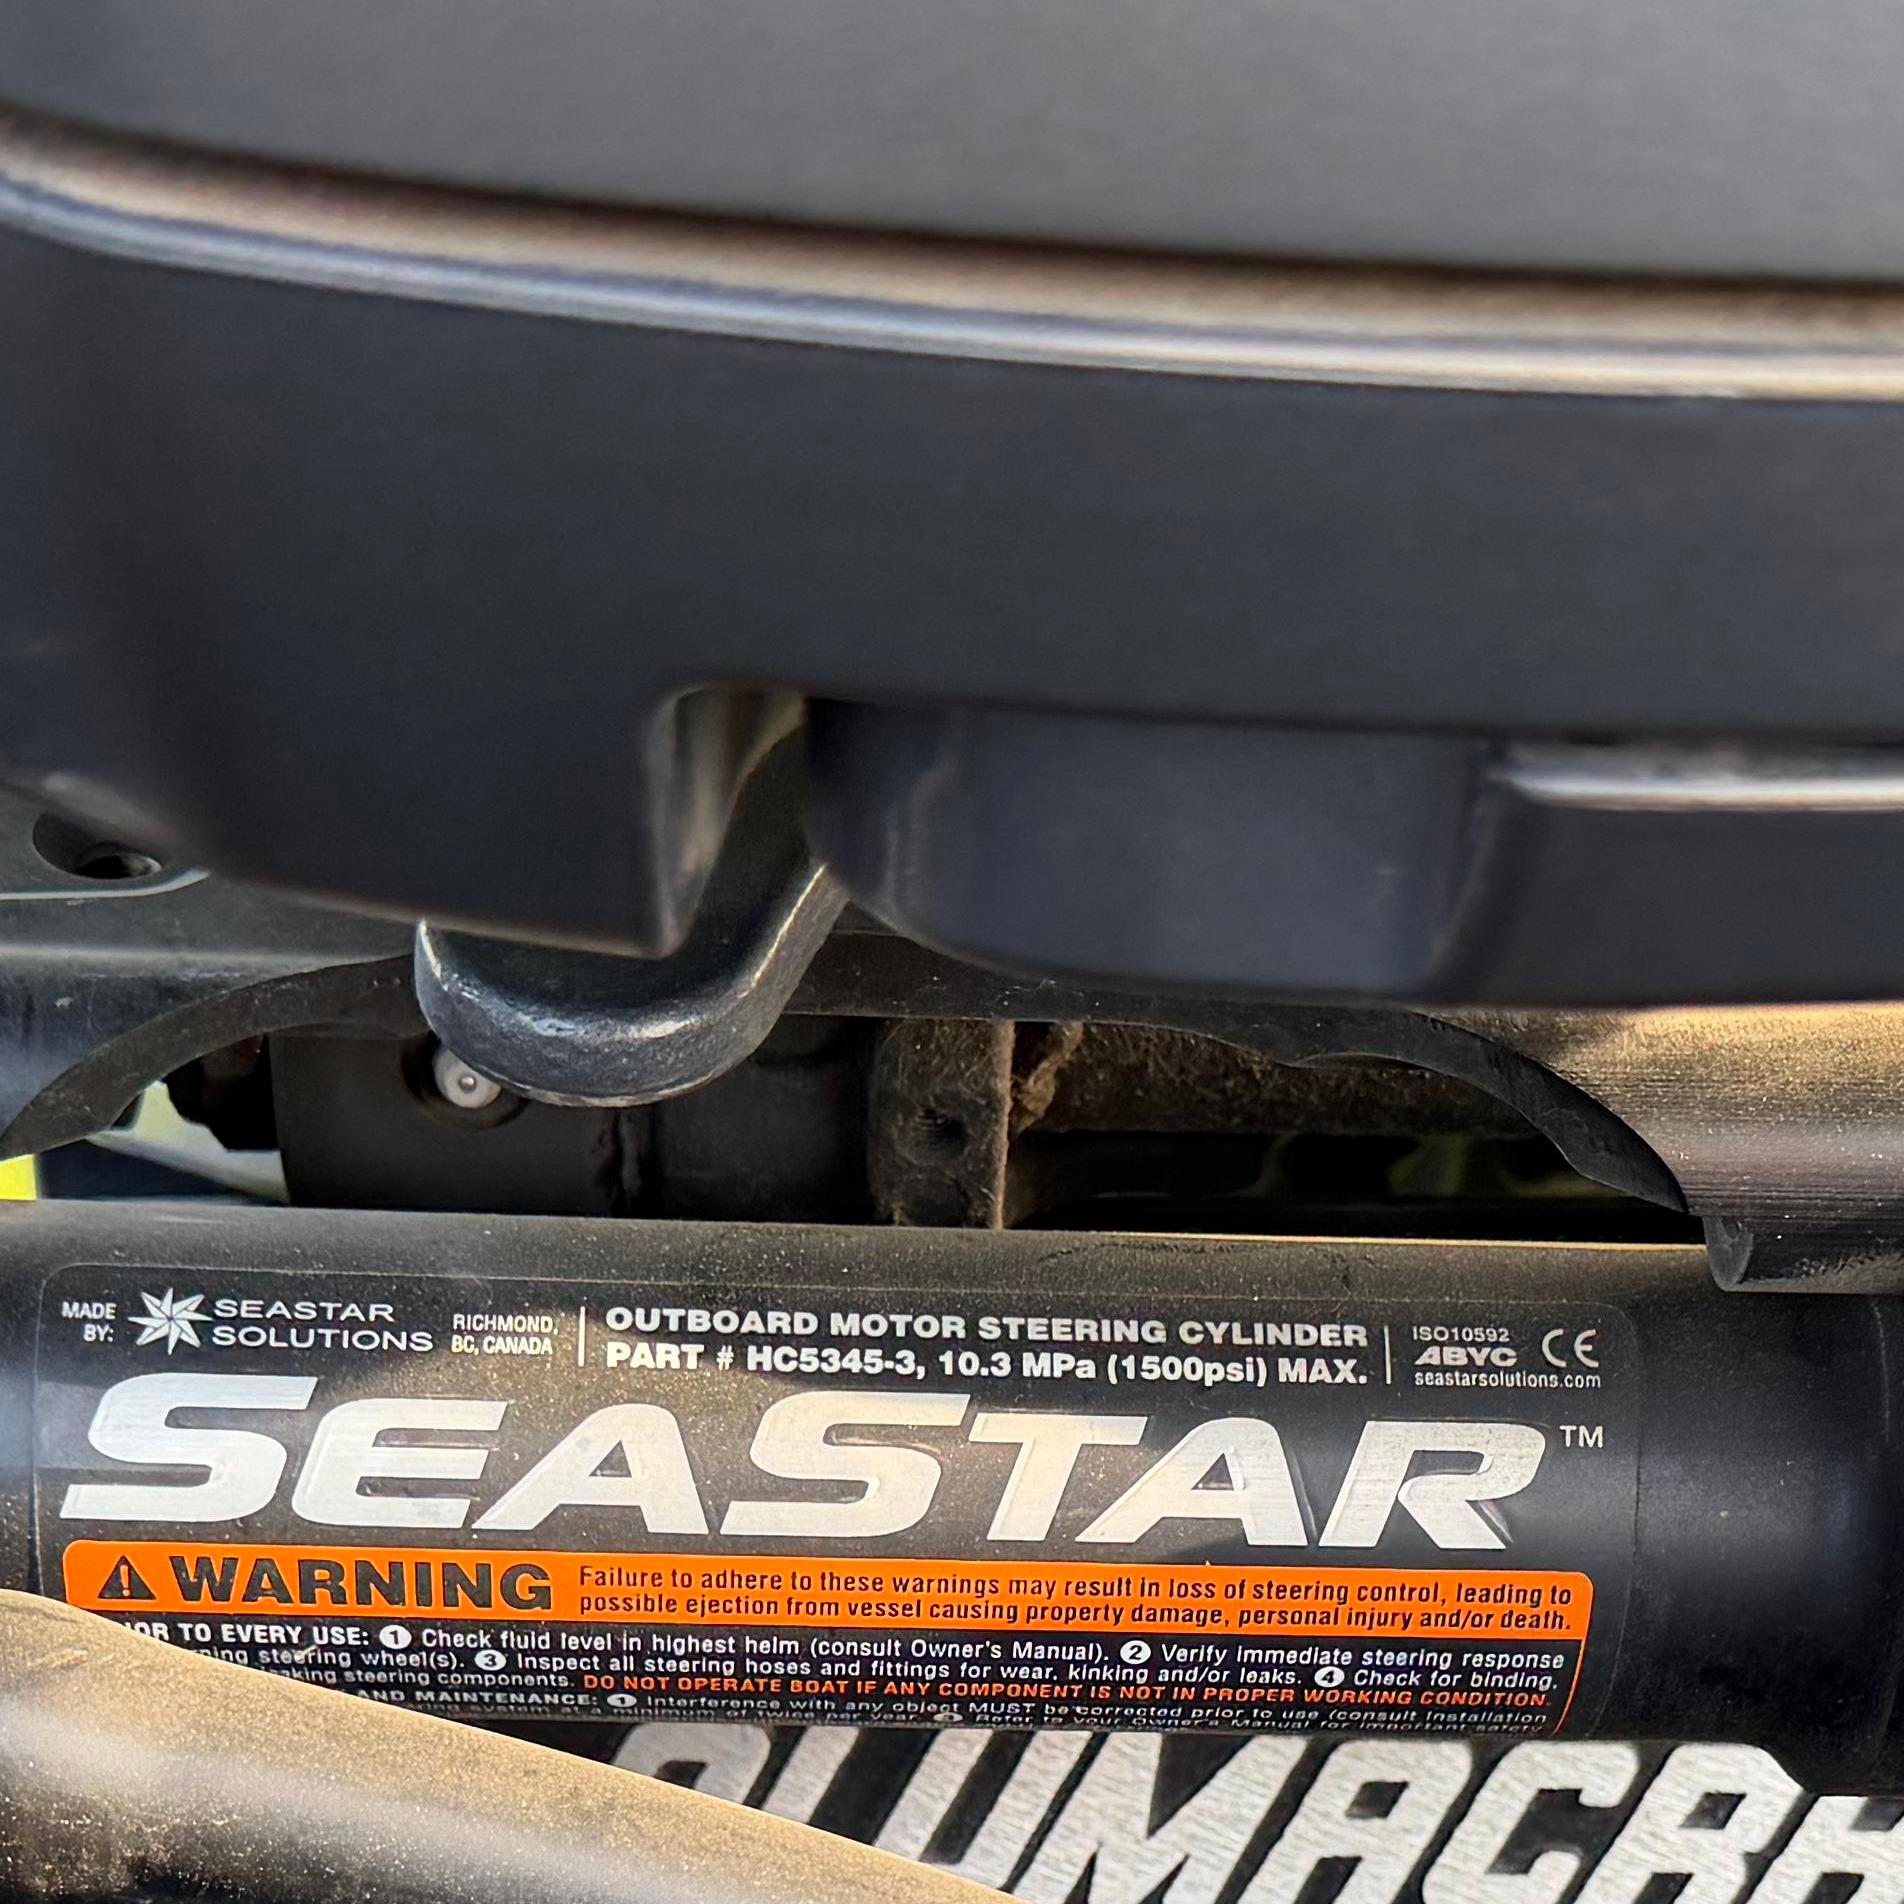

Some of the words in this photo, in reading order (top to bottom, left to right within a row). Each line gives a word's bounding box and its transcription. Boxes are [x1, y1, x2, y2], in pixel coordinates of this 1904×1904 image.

[61, 1301, 116, 1321] MADE
[213, 1299, 395, 1322] SEASTAR
[453, 1313, 559, 1335] RICHMOND,
[82, 1323, 114, 1343] BY:
[211, 1326, 434, 1351] SOLUTIONS
[606, 1307, 819, 1337] OUTBOARD
[829, 1312, 966, 1340] MOTOR
[978, 1316, 1167, 1344] STEERING
[1179, 1322, 1368, 1347] CYLINDER
[1412, 1326, 1510, 1342] ISO10592
[451, 1335, 479, 1357] BC,
[482, 1336, 554, 1356] CANADA
[1414, 1346, 1518, 1367] ABYC
[606, 1342, 704, 1369] PART
[717, 1346, 734, 1371] #
[747, 1347, 925, 1380] HC5345-3,
[939, 1351, 1011, 1378] 10.3
[1022, 1353, 1096, 1381] MPa
[1107, 1354, 1268, 1388] (1500psi)
[1278, 1358, 1368, 1386] MAX.
[1414, 1370, 1602, 1389] seastarsolutions.com
[59, 1371, 1546, 1551] SEASTAR
[169, 1555, 553, 1610] WARNING
[580, 1566, 663, 1589] Failure
[671, 1570, 693, 1589] to
[701, 1570, 783, 1591] adhere
[791, 1571, 813, 1591] to
[821, 1572, 884, 1593] these
[893, 1575, 1000, 1599] warnings
[1008, 1580, 1057, 1600] may
[1064, 1576, 1132, 1598] result
[1140, 1578, 1160, 1598] in
[1168, 1578, 1217, 1600] loss
[1224, 1579, 1248, 1601] of
[1253, 1581, 1349, 1606] steering
[1356, 1583, 1447, 1608] control,
[1456, 1583, 1543, 1609] leading
[1550, 1585, 1572, 1605] to
[580, 1594, 678, 1617] possible
[686, 1595, 779, 1618] ejection
[787, 1597, 840, 1617] from
[848, 1598, 922, 1619] vessel
[930, 1600, 1019, 1625] causing
[1026, 1602, 1124, 1625] property
[1131, 1604, 1230, 1630] damage,
[1238, 1606, 1340, 1629] personal
[1347, 1607, 1413, 1632] injury
[1419, 1608, 1494, 1630] and/or
[1501, 1608, 1572, 1632] death.
[177, 1622, 212, 1643] TO
[223, 1625, 302, 1645] EVERY
[313, 1627, 368, 1647] USE:
[422, 1628, 492, 1649] Check
[500, 1631, 550, 1651] fluid
[561, 1632, 612, 1652] level
[623, 1636, 642, 1652] in
[653, 1634, 736, 1657] highest
[745, 1636, 799, 1656] helm
[810, 1637, 901, 1660] (consult
[911, 1640, 1002, 1660] Owner's
[1012, 1641, 1109, 1664] Manual).
[1162, 1644, 1227, 1666] Verify
[1237, 1647, 1352, 1667] immediate
[1361, 1650, 1453, 1670] steering
[1462, 1655, 1564, 1672] response
[259, 1649, 351, 1669] steering
[361, 1652, 464, 1671] wheel(s).
[518, 1654, 600, 1674] Inspect
[610, 1655, 634, 1673] all
[645, 1656, 736, 1677] steering
[746, 1657, 811, 1677] hoses
[821, 1658, 861, 1677] and
[871, 1660, 949, 1681] fittings
[960, 1663, 991, 1680] for
[1069, 1664, 1149, 1685] kinking
[1158, 1665, 1230, 1684] and/or
[1240, 1667, 1302, 1685] leaks.
[1353, 1670, 1420, 1687] Check
[1431, 1671, 1460, 1687] for
[1471, 1672, 1558, 1691] binding.
[345, 1668, 430, 1686] steering
[437, 1672, 575, 1690] components.
[583, 1675, 615, 1690] DO
[623, 1676, 671, 1691] NOT
[677, 1678, 782, 1693] OPERATE
[790, 1680, 849, 1694] BOAT
[857, 1681, 878, 1695] IF
[884, 1682, 931, 1696] ANY
[938, 1683, 1083, 1698] COMPONENT
[1090, 1685, 1111, 1698] IS
[1119, 1686, 1166, 1699] NOT
[1173, 1687, 1195, 1700] IN
[1203, 1687, 1296, 1702] PROPER
[1304, 1689, 1412, 1705] WORKING
[1420, 1692, 1552, 1707] CONDITION.
[414, 1691, 598, 1706] MAINTENANCE:
[789, 1699, 836, 1711] with
[845, 1702, 883, 1715] any
[892, 1702, 960, 1715] object
[969, 1702, 1036, 1714] MUST
[1044, 1704, 1069, 1715] be
[1076, 1705, 1182, 1718] corrected
[1191, 1707, 1246, 1720] prior
[1253, 1708, 1273, 1719] to
[1282, 1711, 1319, 1721] use
[1329, 1710, 1417, 1723] (consult
